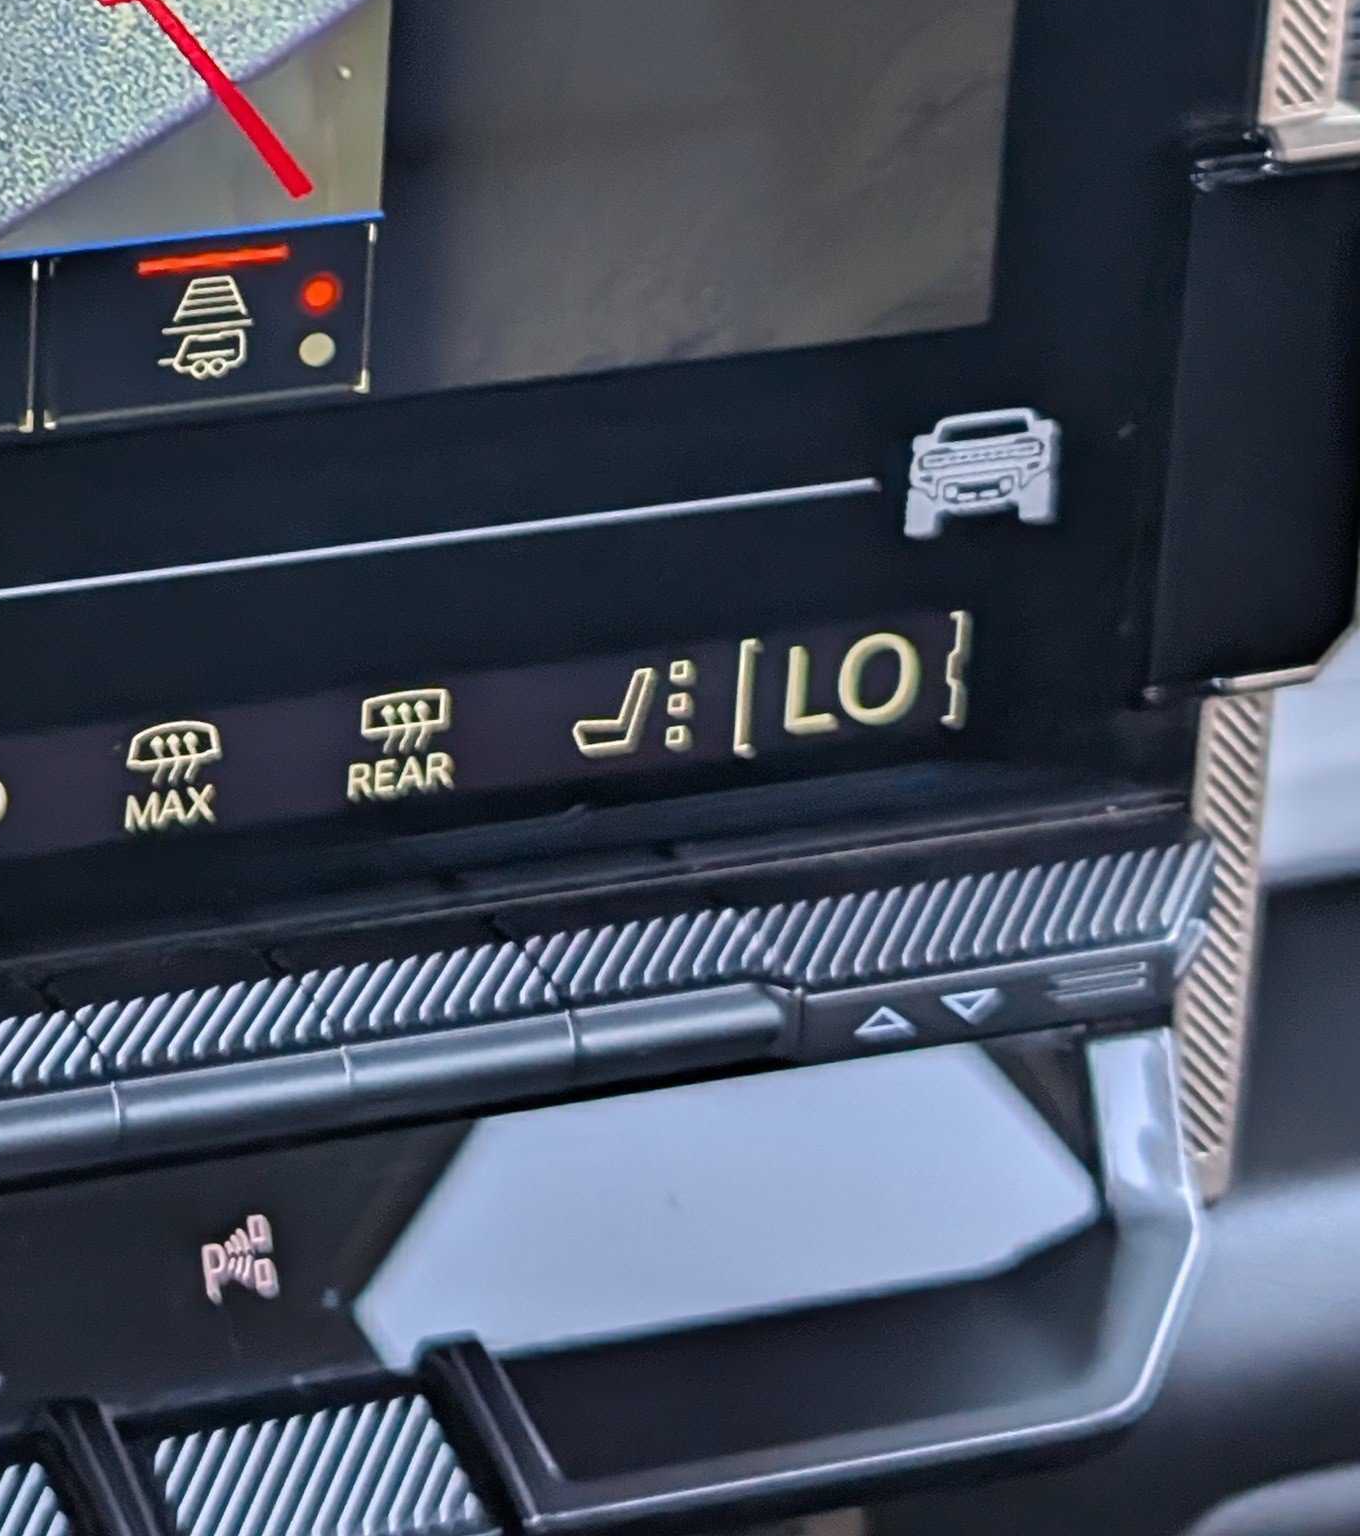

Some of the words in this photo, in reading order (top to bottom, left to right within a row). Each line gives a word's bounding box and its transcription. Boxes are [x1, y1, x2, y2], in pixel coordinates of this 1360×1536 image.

[784, 632, 920, 735] LO
[346, 750, 455, 801] REAR
[124, 784, 216, 832] MAX
